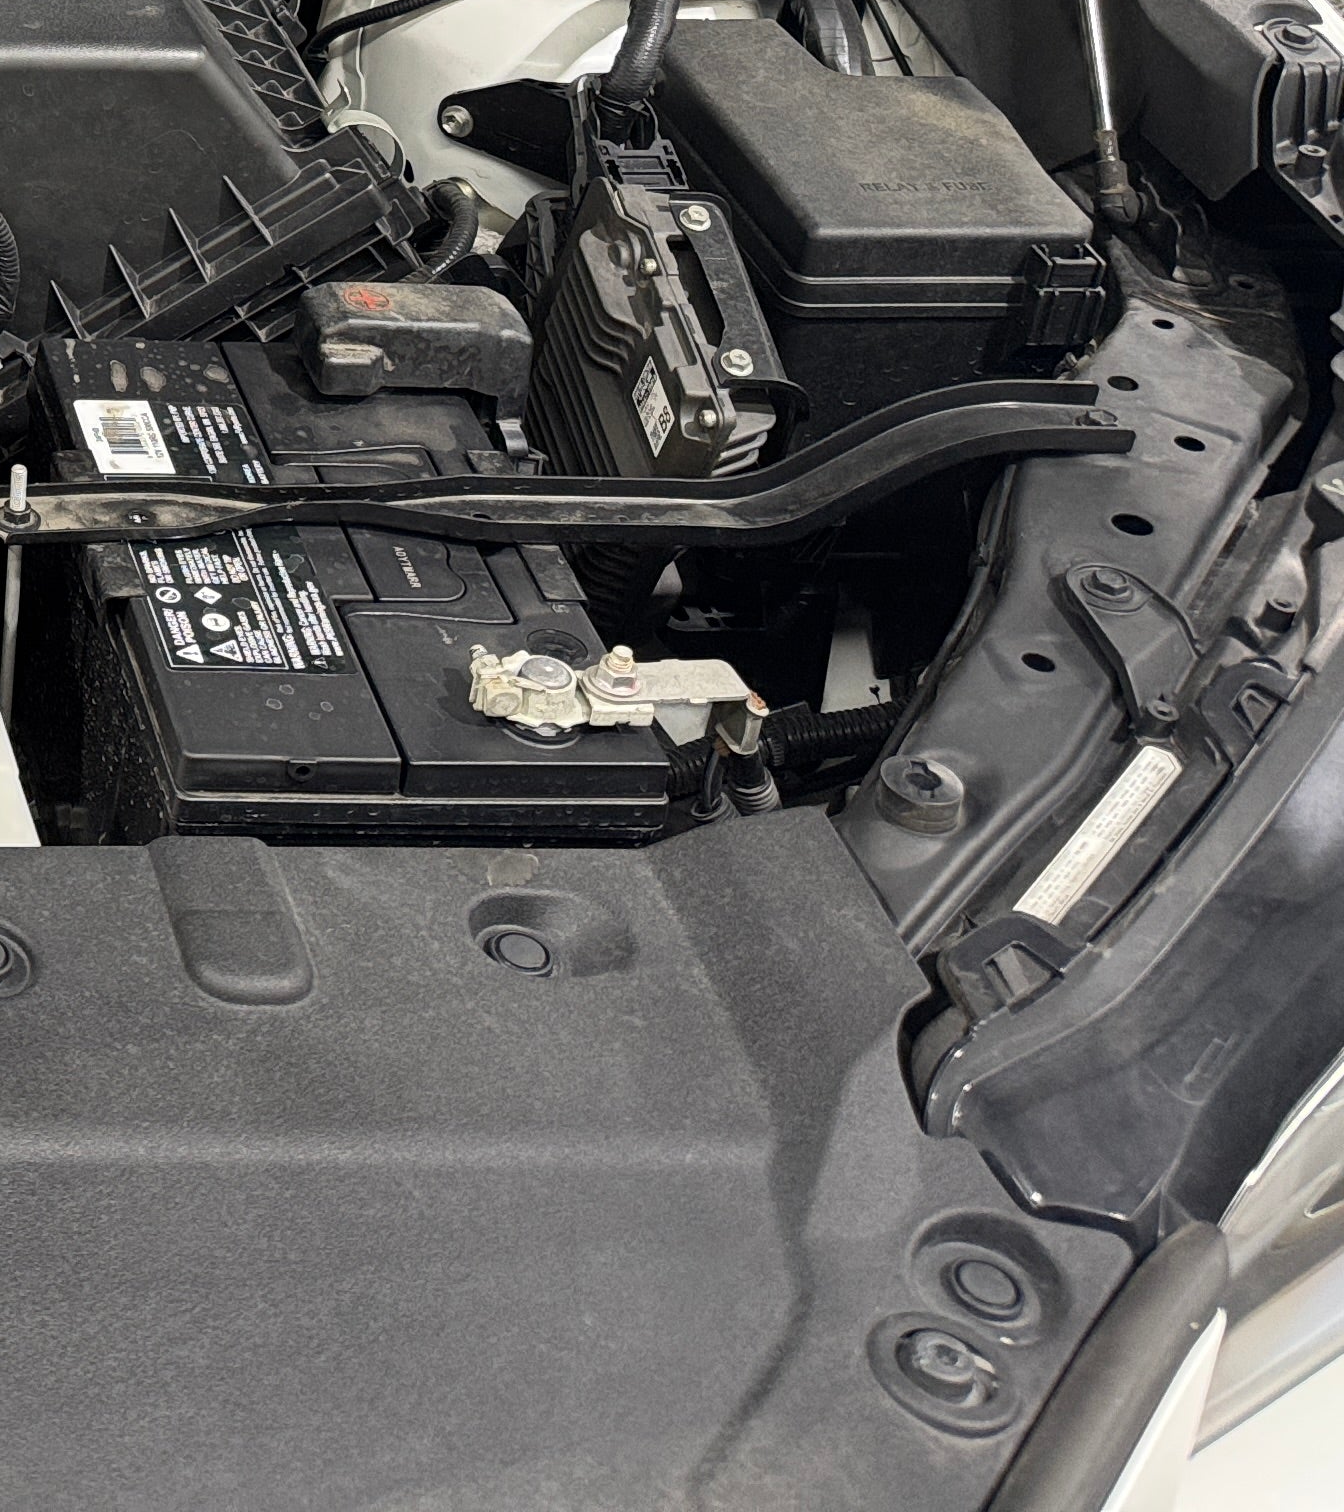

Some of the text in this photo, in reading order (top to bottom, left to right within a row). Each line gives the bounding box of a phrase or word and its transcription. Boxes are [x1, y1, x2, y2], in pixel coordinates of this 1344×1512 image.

[858, 181, 920, 192] RELAY
[161, 606, 186, 645] DANGER/
[174, 610, 197, 643] POISON
